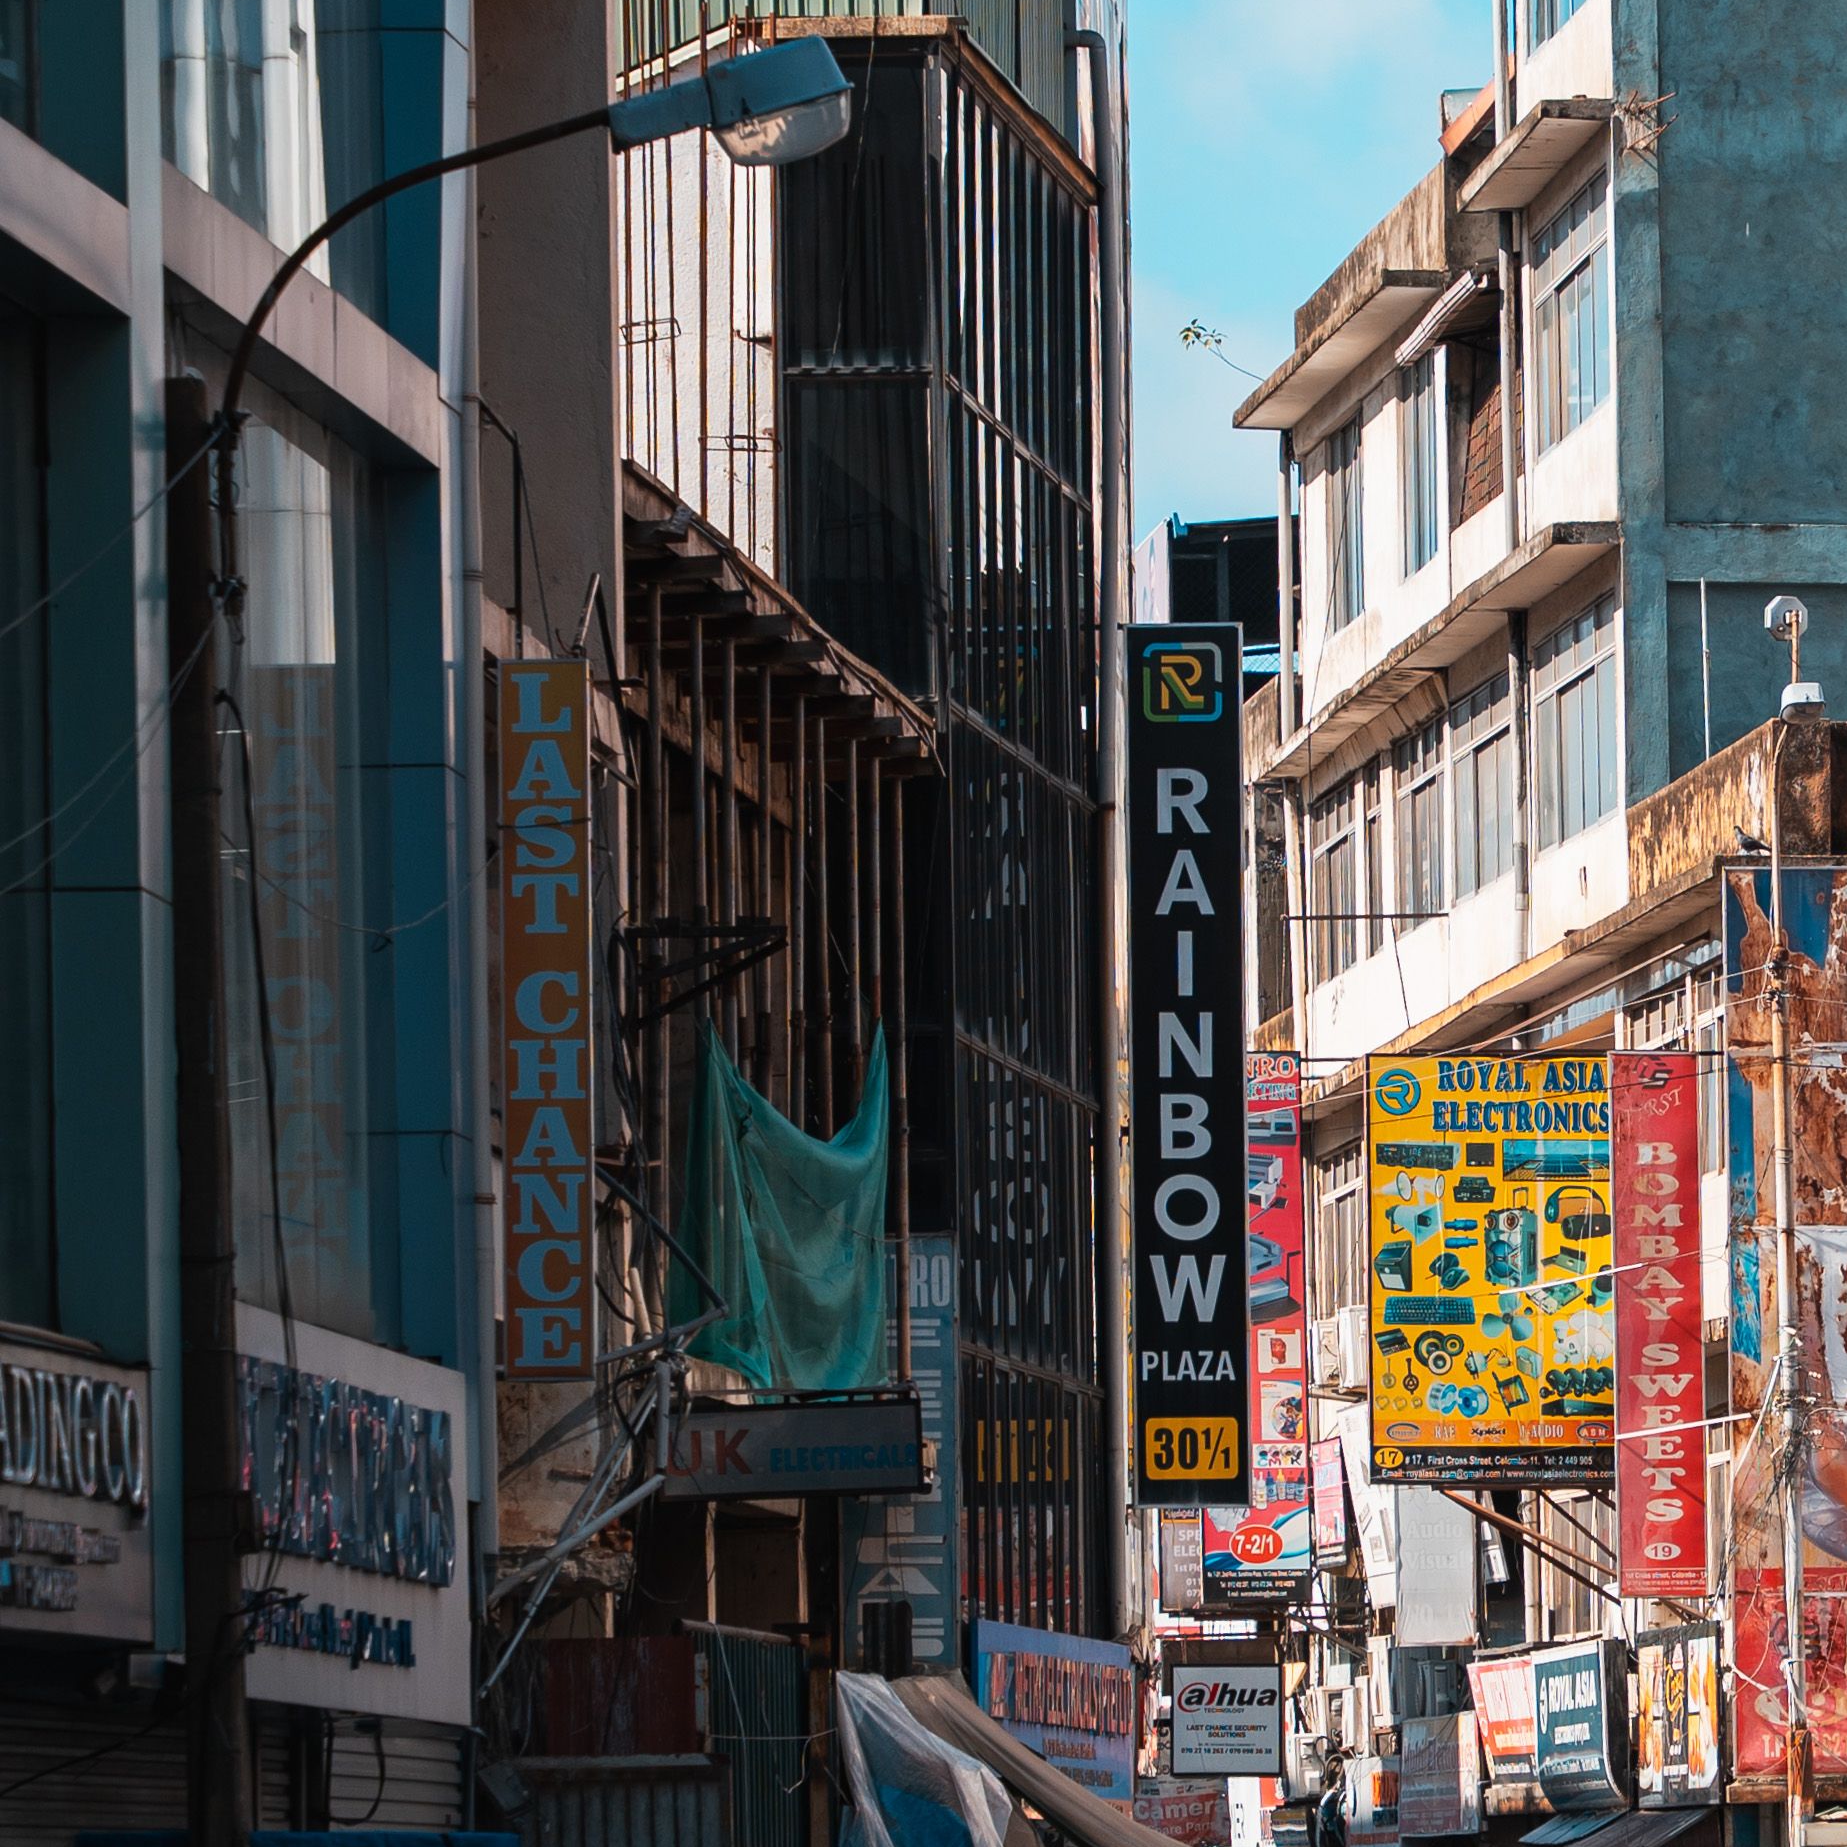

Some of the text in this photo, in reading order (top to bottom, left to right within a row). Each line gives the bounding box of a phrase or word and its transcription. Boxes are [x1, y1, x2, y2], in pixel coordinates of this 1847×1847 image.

[511, 671, 581, 936] LAST
[1148, 768, 1227, 1324] RAINBOW
[1437, 1060, 1607, 1093] ROYAL ASIA
[1431, 1100, 1609, 1134] ELECTRONICS
[513, 969, 584, 1368] CHANCE
[1631, 1141, 1685, 1321] BOMBAY
[1141, 1351, 1236, 1382] PLAZA
[1628, 1341, 1695, 1522] SWEETS
[769, 1441, 920, 1474] ELECTRICALS
[1378, 1449, 1400, 1467] 17
[1234, 1534, 1275, 1555] 7-2/1
[1406, 1517, 1463, 1539] Audio
[1402, 1549, 1466, 1571] Visual
[1650, 1545, 1673, 1558] 19
[1548, 1669, 1597, 1714] ROYAL ASIA
[1186, 1724, 1204, 1732] LAST
